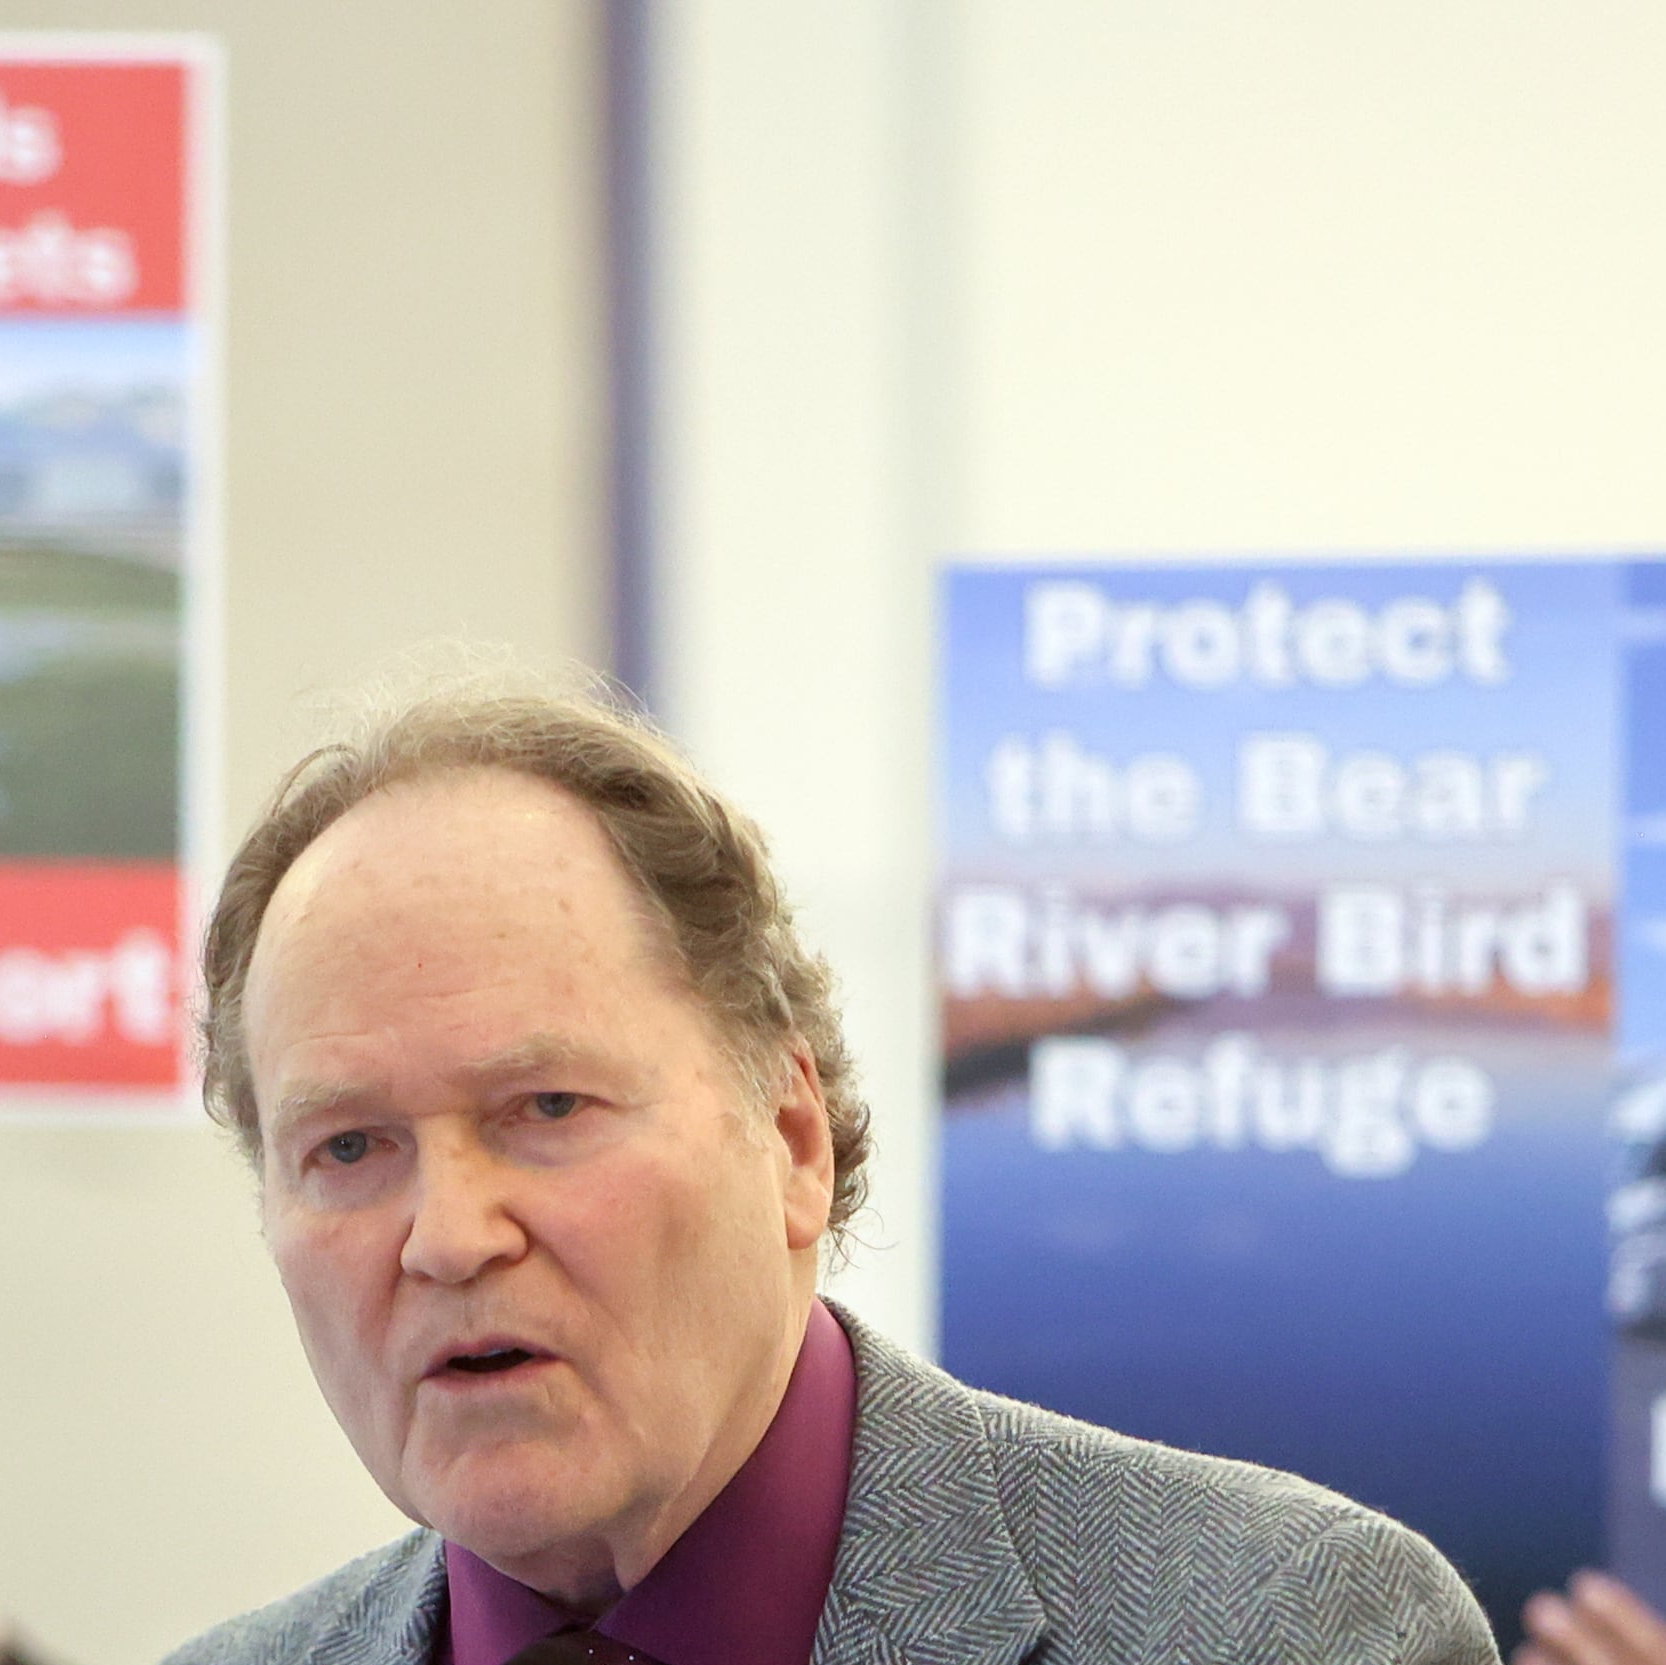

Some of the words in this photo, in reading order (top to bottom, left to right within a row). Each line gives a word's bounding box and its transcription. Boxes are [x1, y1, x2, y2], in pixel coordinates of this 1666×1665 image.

[1021, 580, 1511, 688] Protect
[988, 736, 1201, 845] the
[1238, 736, 1541, 838] Bear
[948, 888, 1288, 995] River
[1318, 885, 1588, 992] Bird
[1028, 1040, 1498, 1178] Refuge
